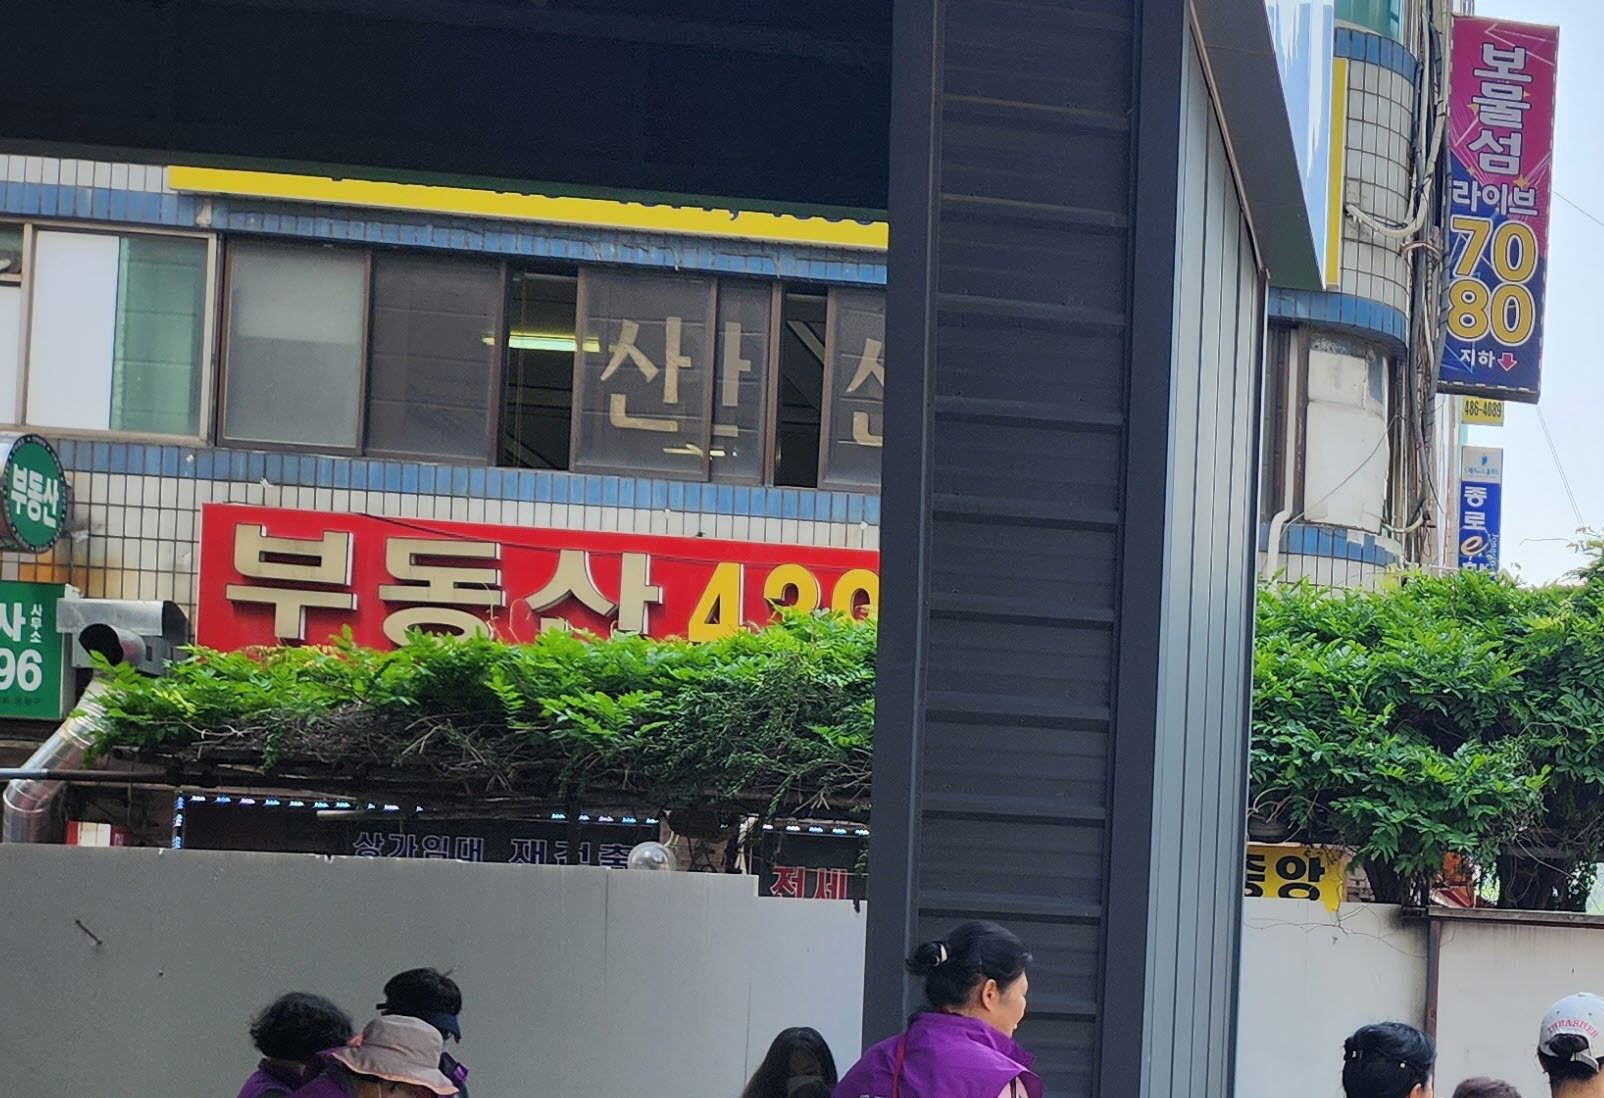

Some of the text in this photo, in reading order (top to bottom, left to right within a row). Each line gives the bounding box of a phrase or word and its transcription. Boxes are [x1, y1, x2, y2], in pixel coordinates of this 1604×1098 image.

[1467, 43, 1533, 177] 보물섬
[1452, 180, 1538, 216] 라이브
[1450, 215, 1538, 283] 70
[1447, 278, 1536, 346] 80
[1460, 348, 1495, 368] 지하
[10, 463, 59, 528] 부동산
[225, 523, 663, 646] 부동산
[29, 604, 43, 644] 사무소
[1547, 1019, 1599, 1039] THRASHER
